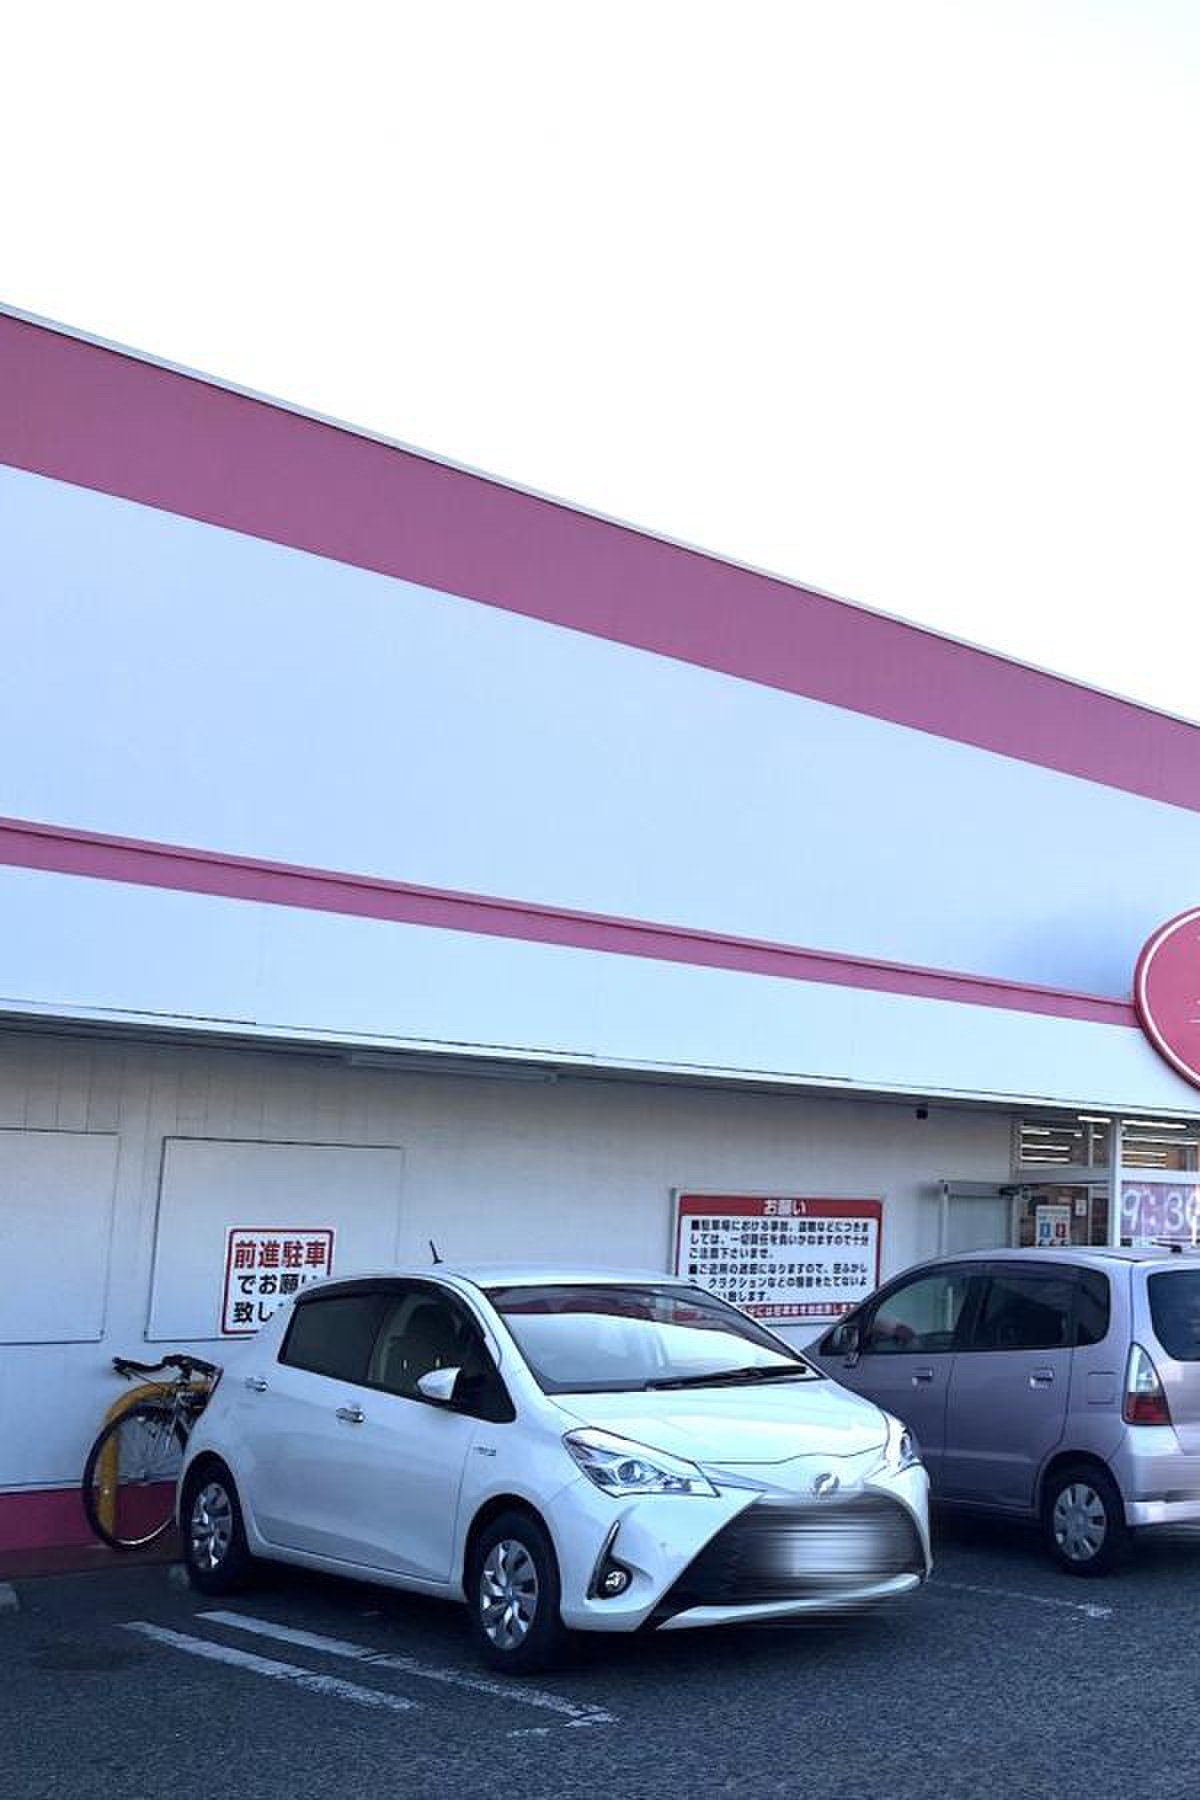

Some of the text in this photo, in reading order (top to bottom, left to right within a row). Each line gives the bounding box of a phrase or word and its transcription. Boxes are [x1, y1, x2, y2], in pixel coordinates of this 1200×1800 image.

[235, 1240, 326, 1268] 前進駐車
[233, 1301, 284, 1323] 致し
